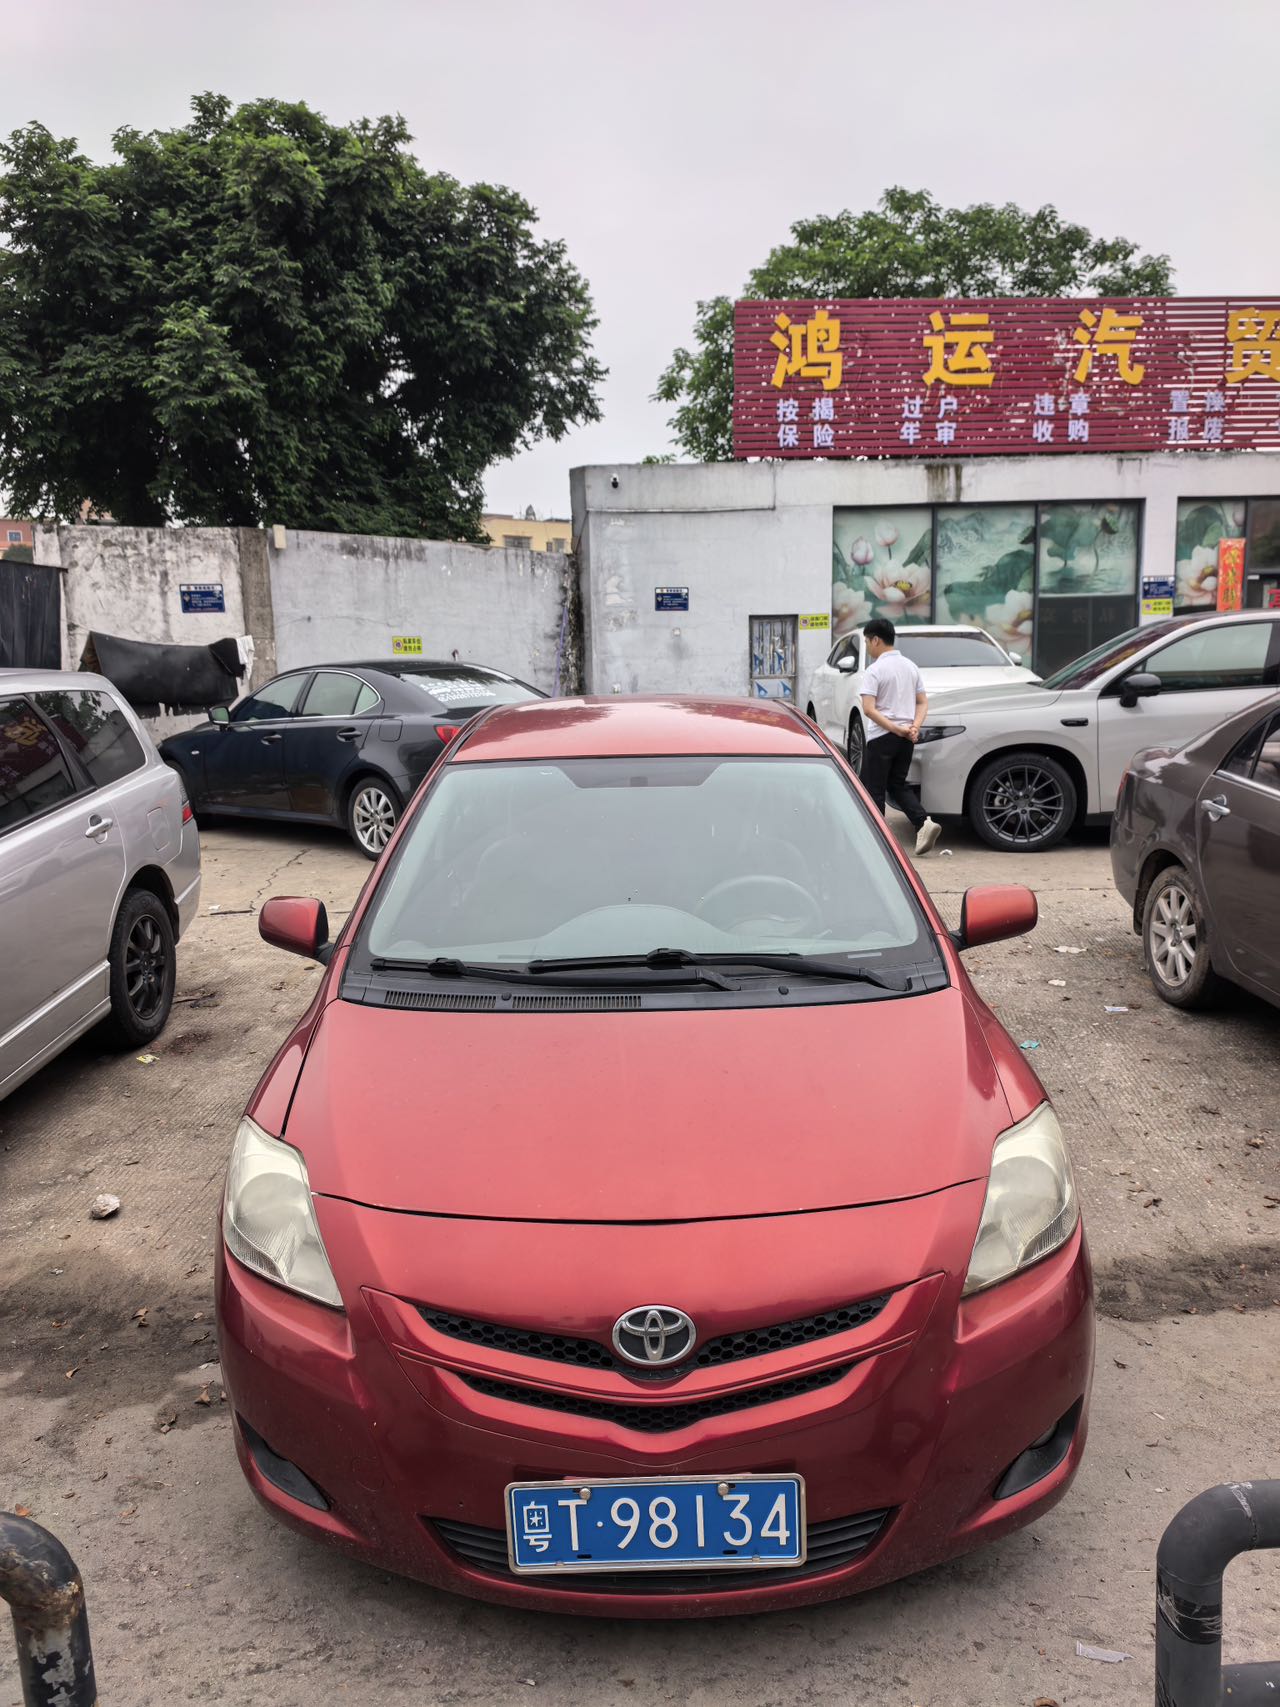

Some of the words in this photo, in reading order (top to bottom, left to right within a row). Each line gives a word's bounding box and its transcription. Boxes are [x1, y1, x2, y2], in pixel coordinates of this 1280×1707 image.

[769, 307, 1280, 391] 鸿运汽贸
[776, 397, 834, 422] 按揭
[902, 396, 959, 419] 过户
[1033, 392, 1091, 416] 违章
[1169, 389, 1226, 413] 置换
[777, 424, 835, 448] 保险
[900, 421, 957, 446] 年审
[1032, 419, 1090, 443] 收购
[1168, 417, 1225, 441] 报废
[522, 1493, 791, 1552] 粤T·98134
